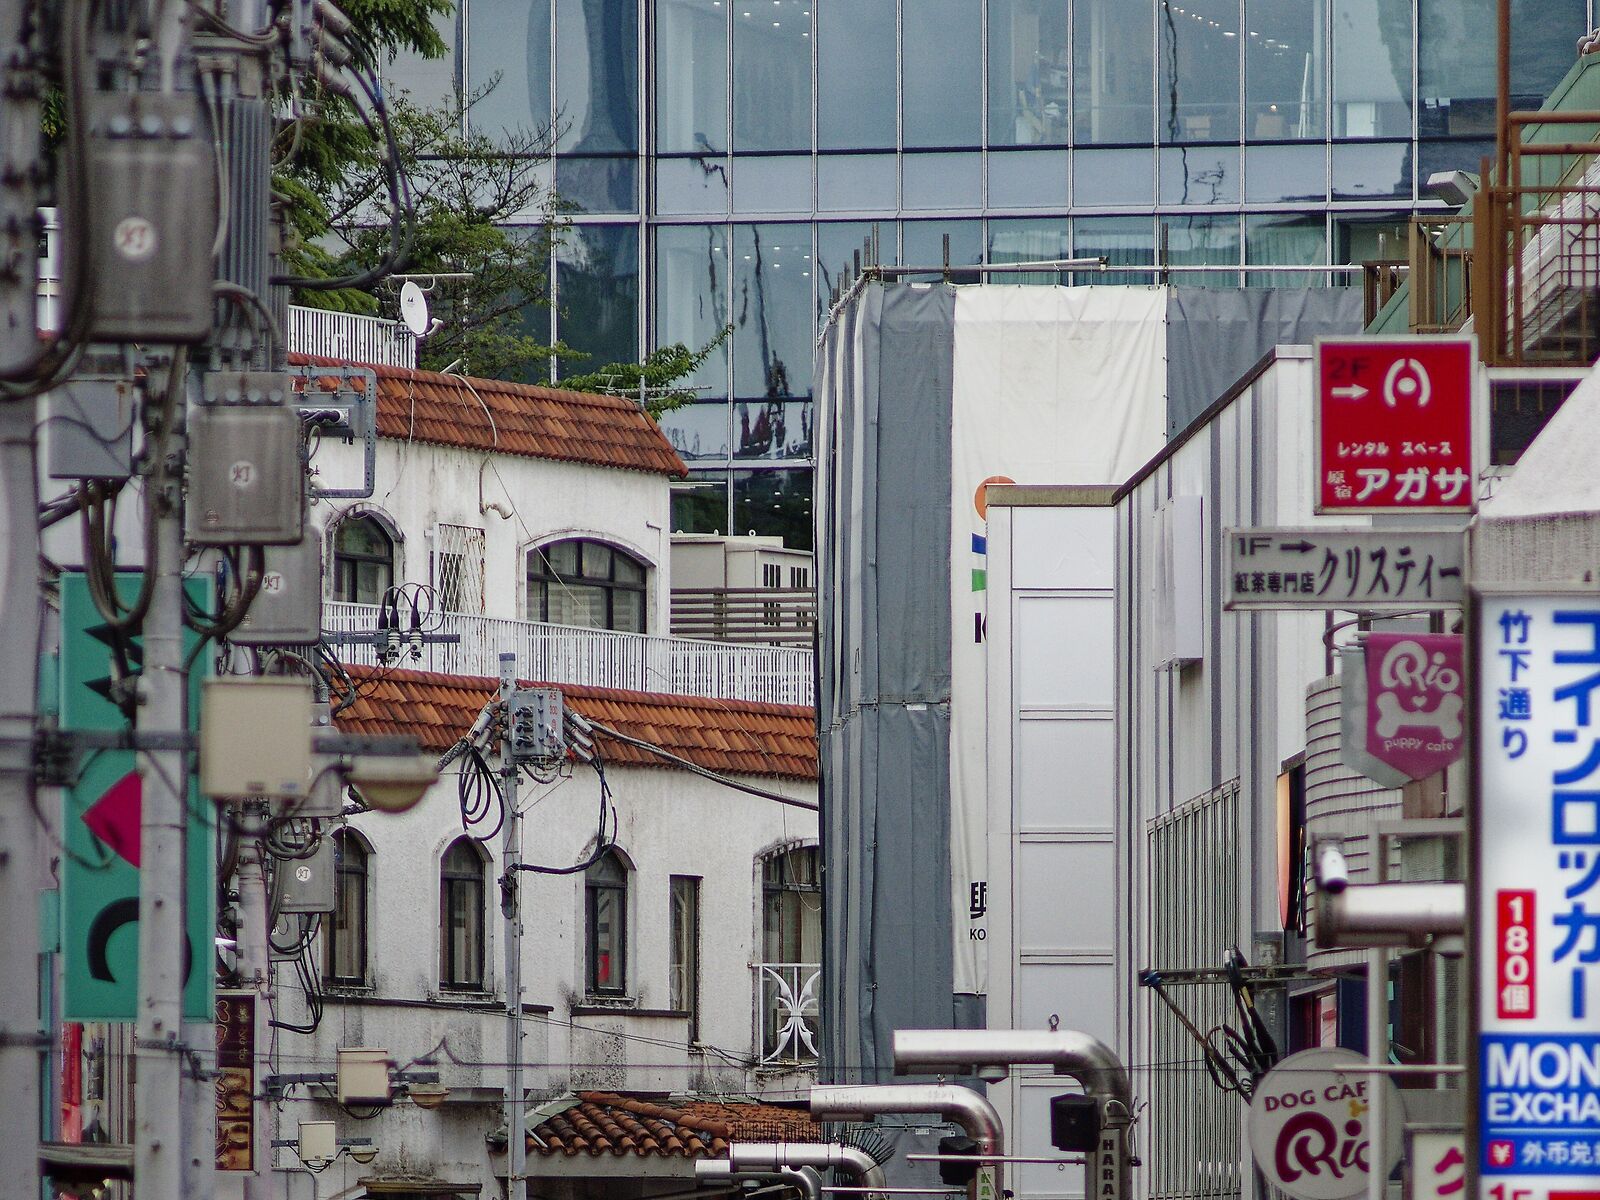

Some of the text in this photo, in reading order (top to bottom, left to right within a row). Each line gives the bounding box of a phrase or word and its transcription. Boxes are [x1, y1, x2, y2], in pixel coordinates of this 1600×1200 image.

[1337, 441, 1452, 456] レンタル スペース
[1355, 467, 1469, 501] アガサ
[1238, 537, 1273, 555] 1F
[1234, 572, 1316, 594] 紅茶専門店
[1316, 546, 1462, 597] クリスティー
[1381, 640, 1460, 692] Rio
[1498, 609, 1533, 760] 竹下通り
[1384, 737, 1424, 752] puppy
[1503, 894, 1531, 1013] 180個
[1264, 1089, 1317, 1112] DOG
